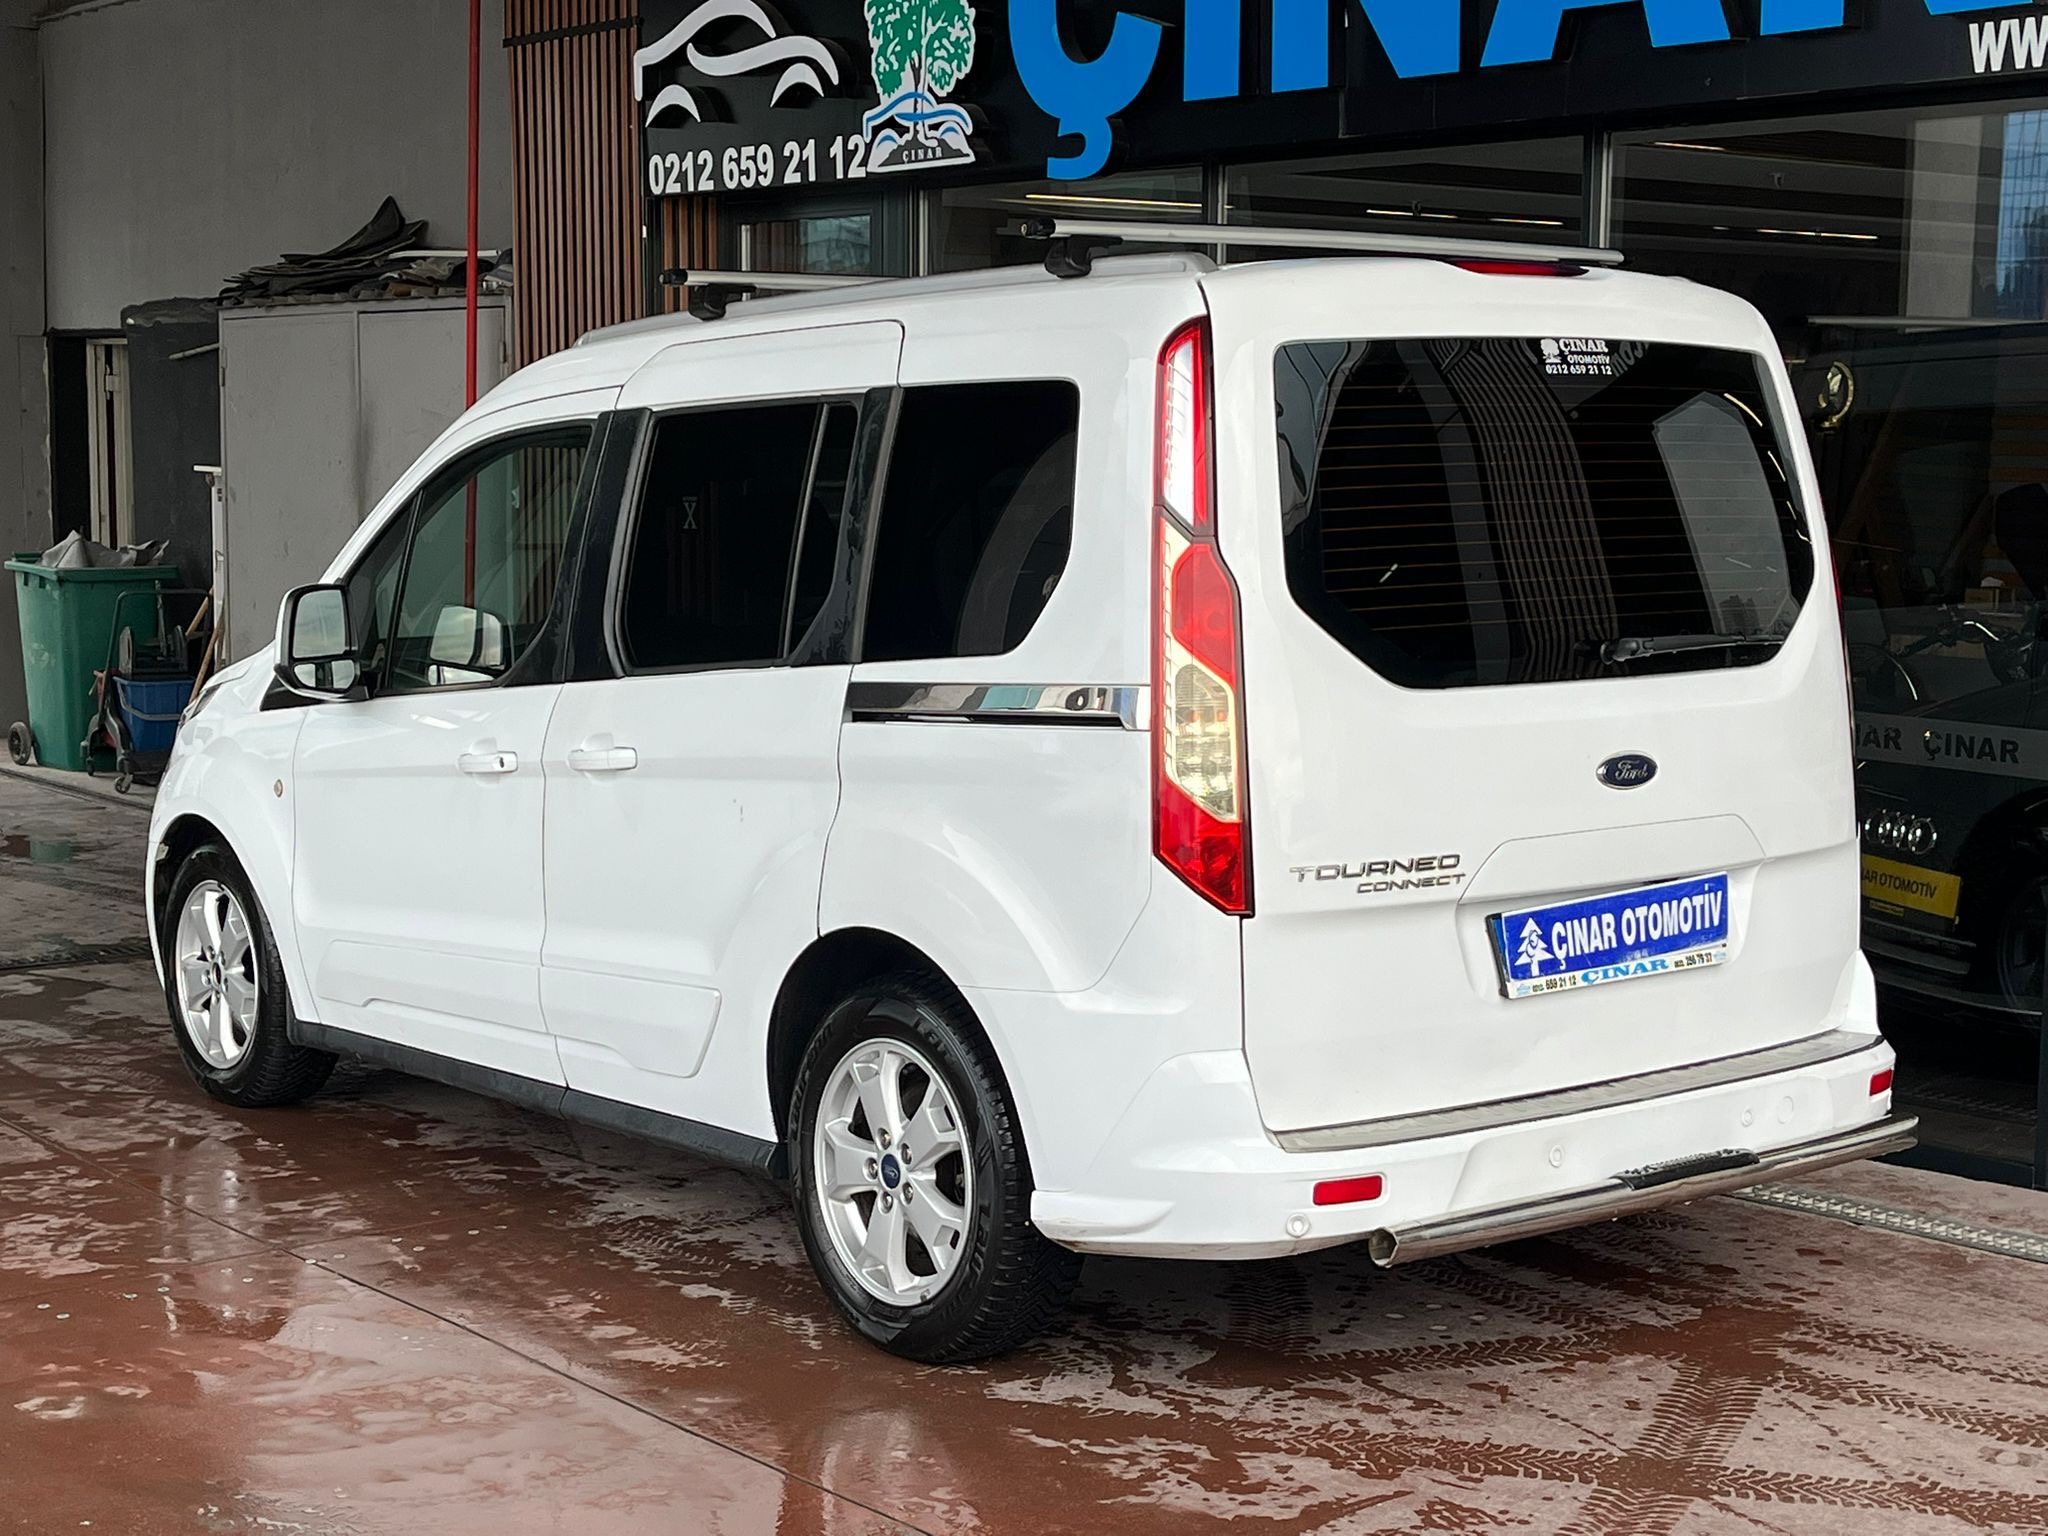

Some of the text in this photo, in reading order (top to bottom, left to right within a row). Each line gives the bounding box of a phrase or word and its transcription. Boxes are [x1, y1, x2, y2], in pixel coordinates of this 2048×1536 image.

[648, 134, 867, 196] 0212 659 21 12
[902, 146, 943, 165] ÇINAR
[1558, 338, 1609, 355] ÇINAR
[1545, 364, 1612, 375] 0212 659 21 12
[1923, 728, 2020, 764] ÇINAR
[1615, 759, 1649, 780] Ford
[1289, 853, 1461, 883] TOURNEO
[1356, 873, 1466, 894] CONNECT
[1551, 883, 1723, 971] ÇINAR OTOMOTİV
[1581, 958, 1669, 986] ÇINAR
